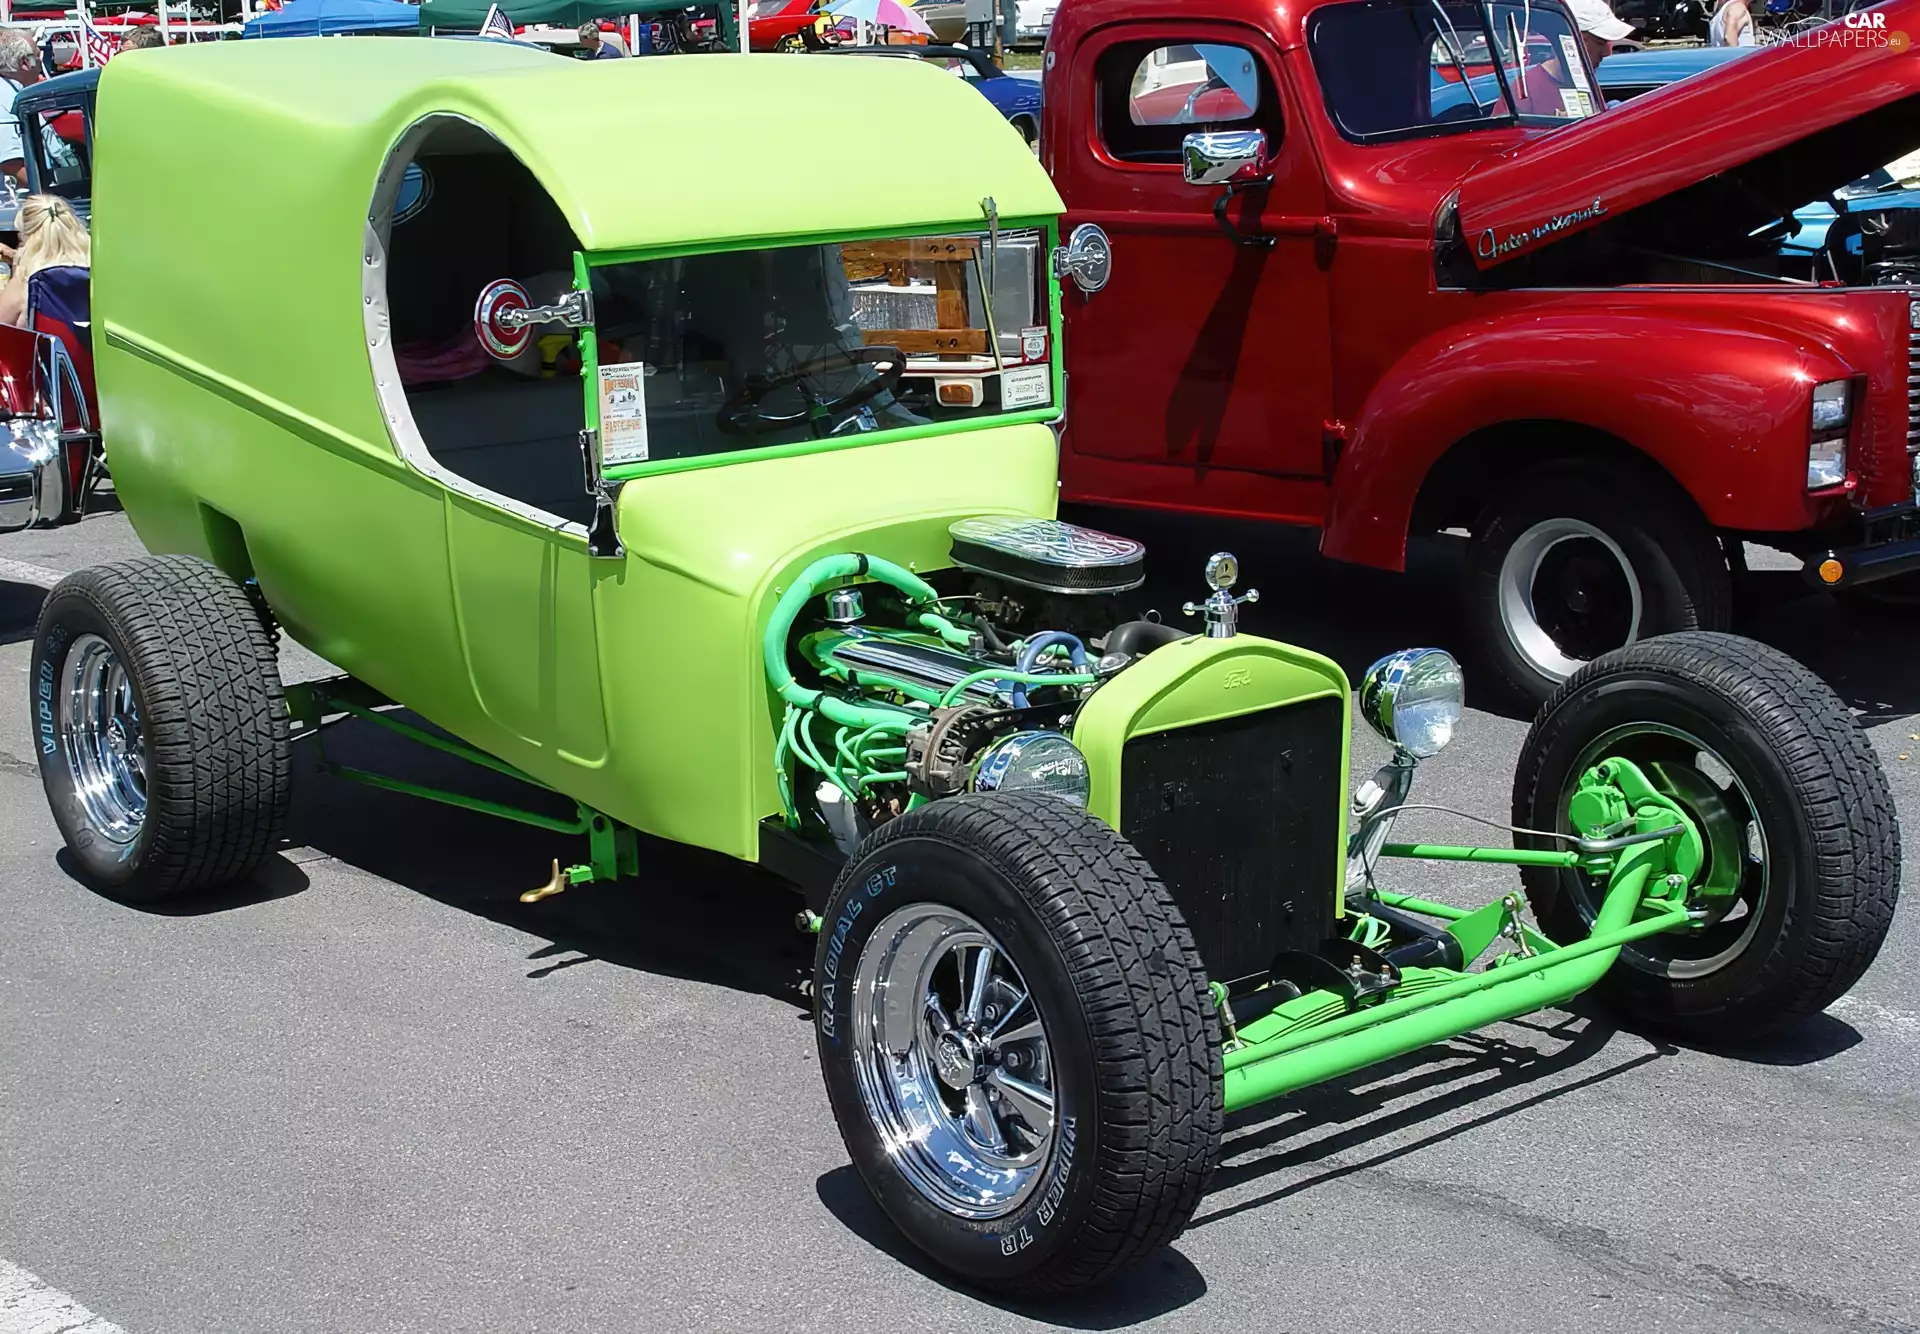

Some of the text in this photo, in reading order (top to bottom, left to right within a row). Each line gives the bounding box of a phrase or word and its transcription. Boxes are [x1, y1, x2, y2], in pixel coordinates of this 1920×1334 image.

[39, 660, 57, 755] VIPER
[821, 899, 863, 1037] RADIAL
[1000, 1116, 1077, 1256] VIPER TR
